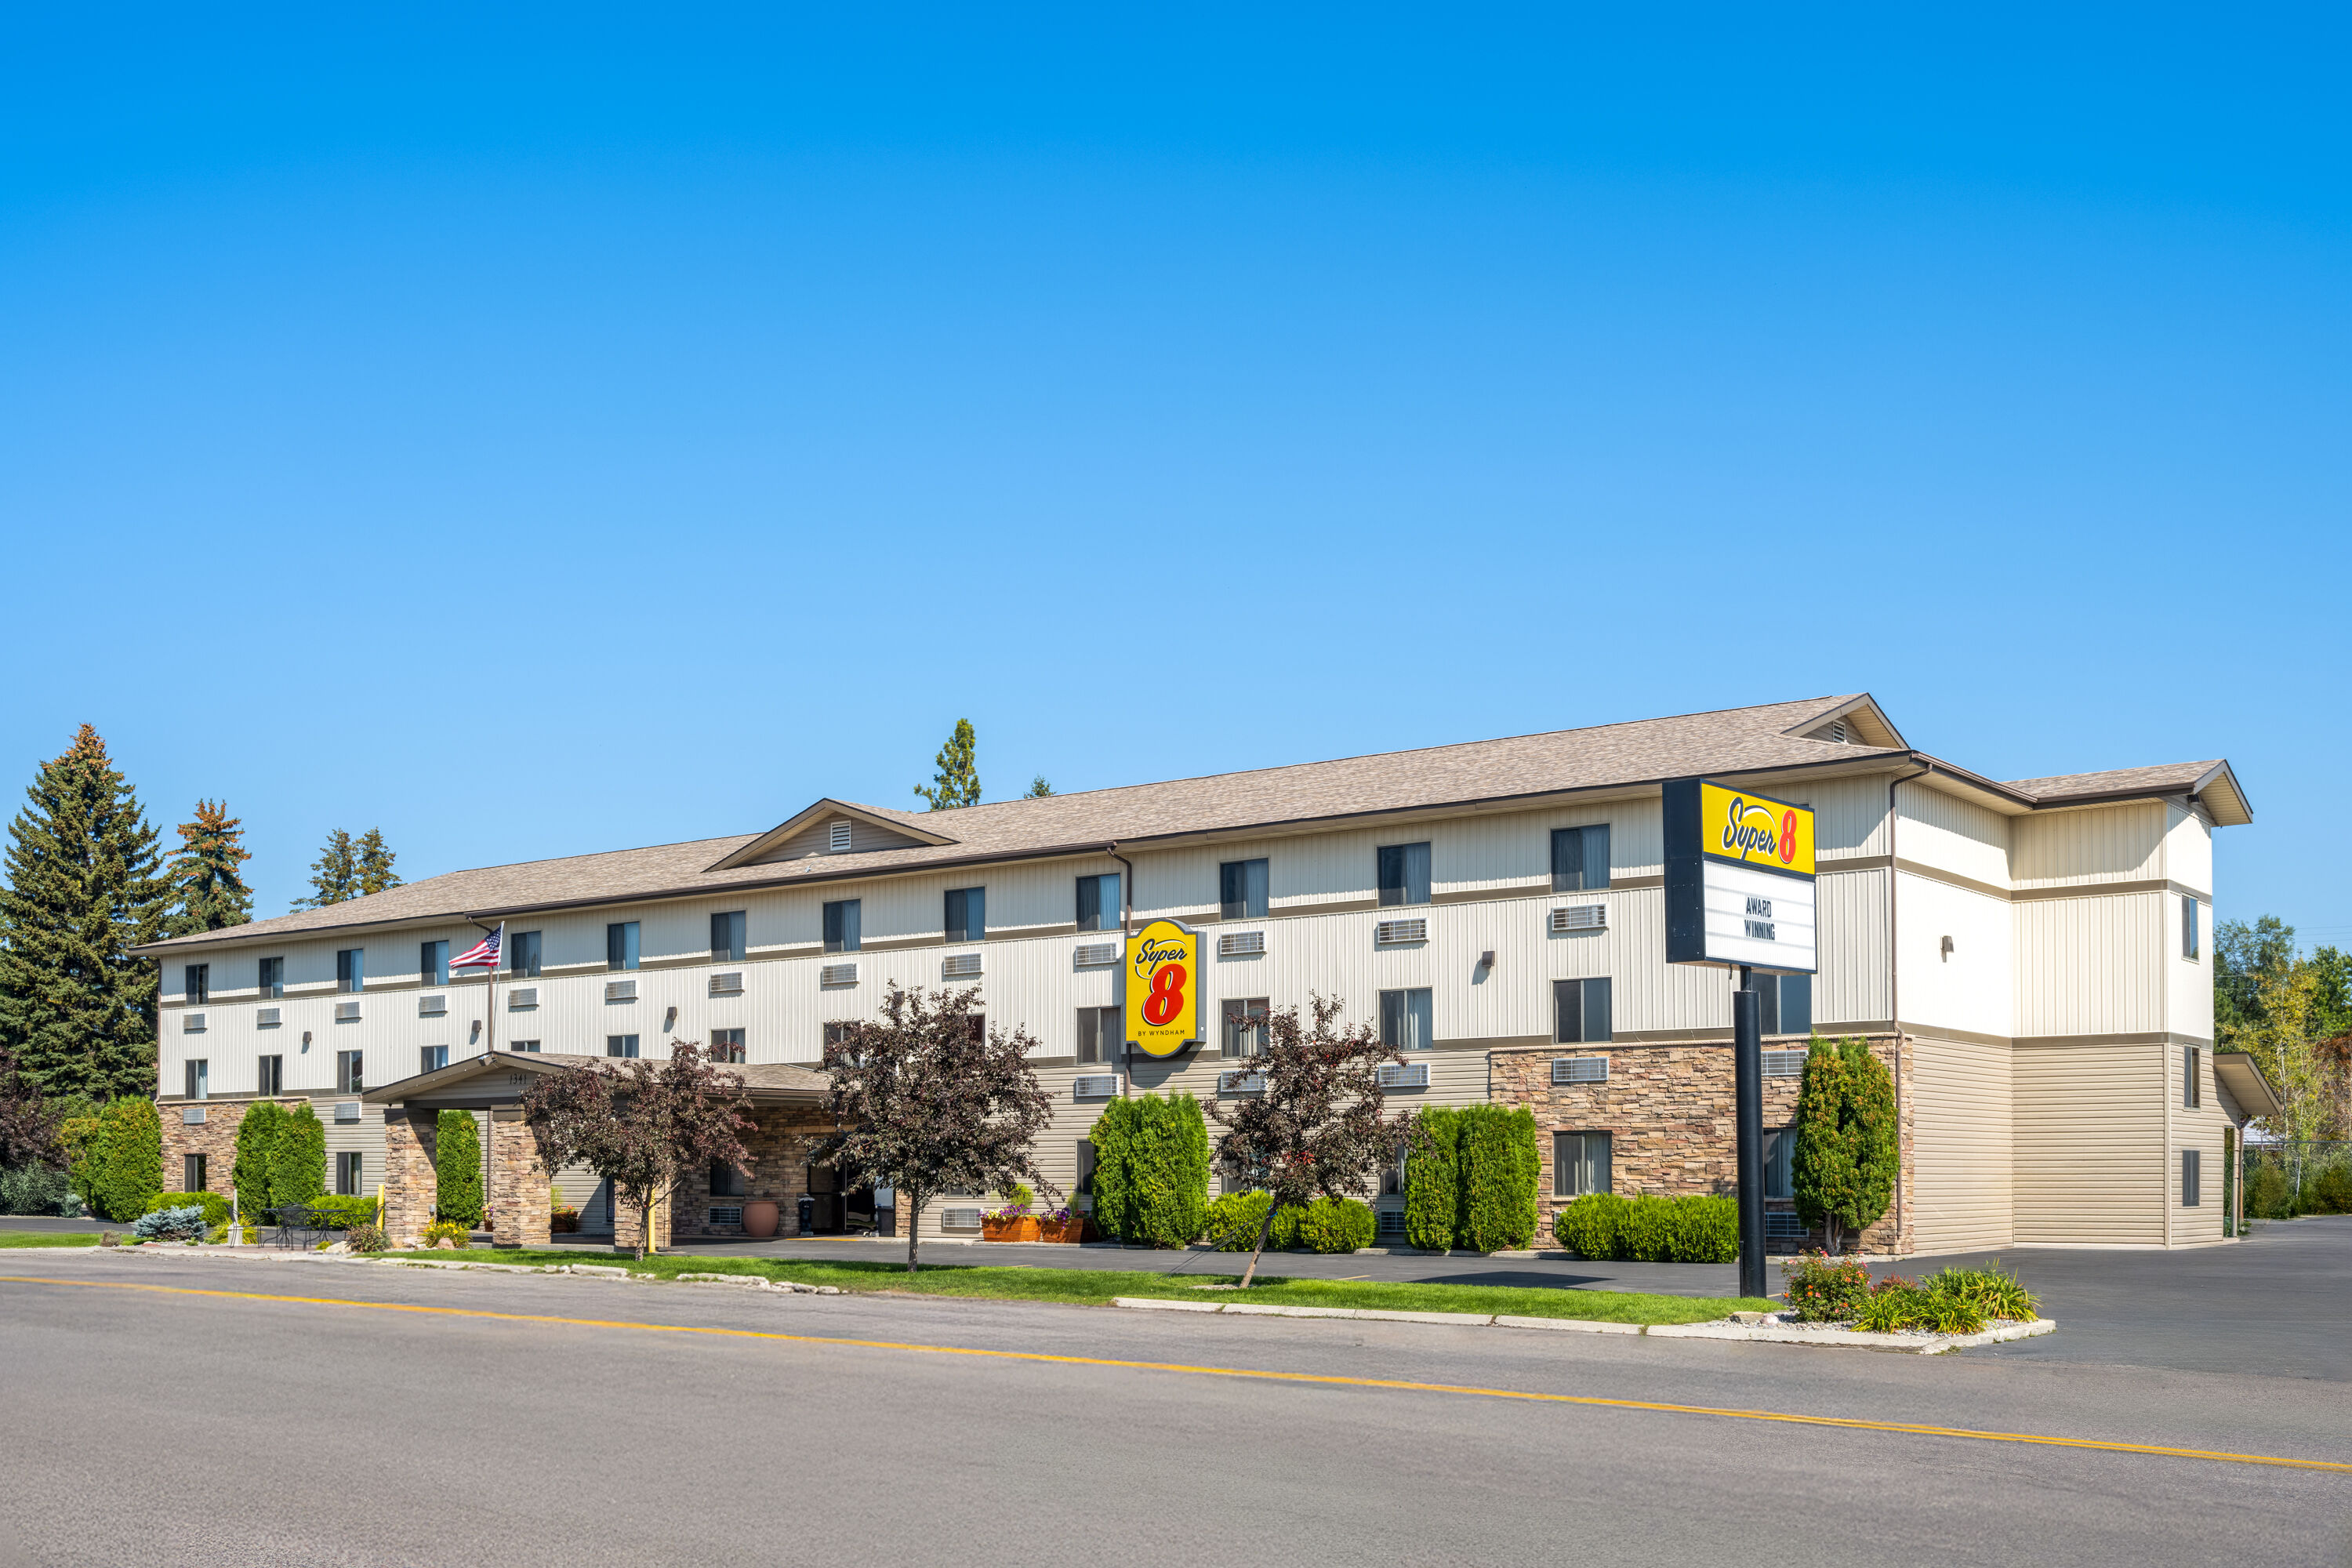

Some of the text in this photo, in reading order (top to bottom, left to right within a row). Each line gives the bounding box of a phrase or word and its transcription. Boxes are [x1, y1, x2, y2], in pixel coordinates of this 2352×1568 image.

[1722, 797, 1797, 864] Super 8
[1746, 897, 1772, 918] AWARD
[1744, 920, 1775, 941] WINNING
[1135, 938, 1188, 976] Super
[1142, 964, 1187, 1026] 8
[509, 1073, 527, 1085] 1341
